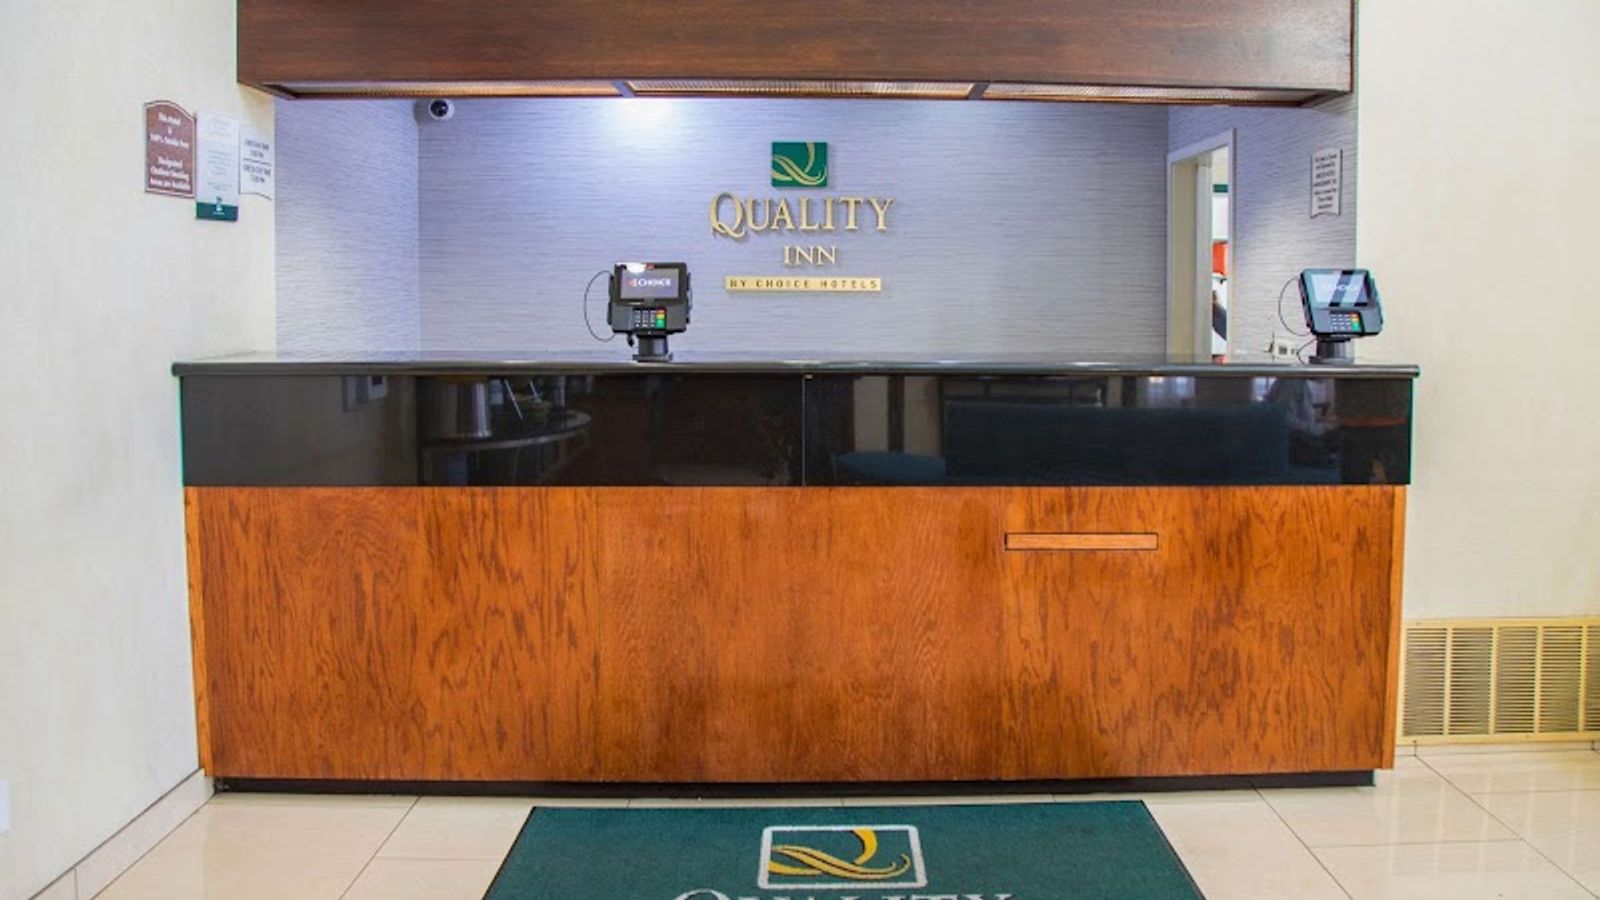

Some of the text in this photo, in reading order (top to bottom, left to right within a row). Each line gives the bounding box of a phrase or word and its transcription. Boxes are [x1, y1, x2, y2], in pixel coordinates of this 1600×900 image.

[709, 192, 896, 239] QUALITY
[783, 245, 837, 265] INN
[729, 279, 879, 289] BY CHOICE HOTELS
